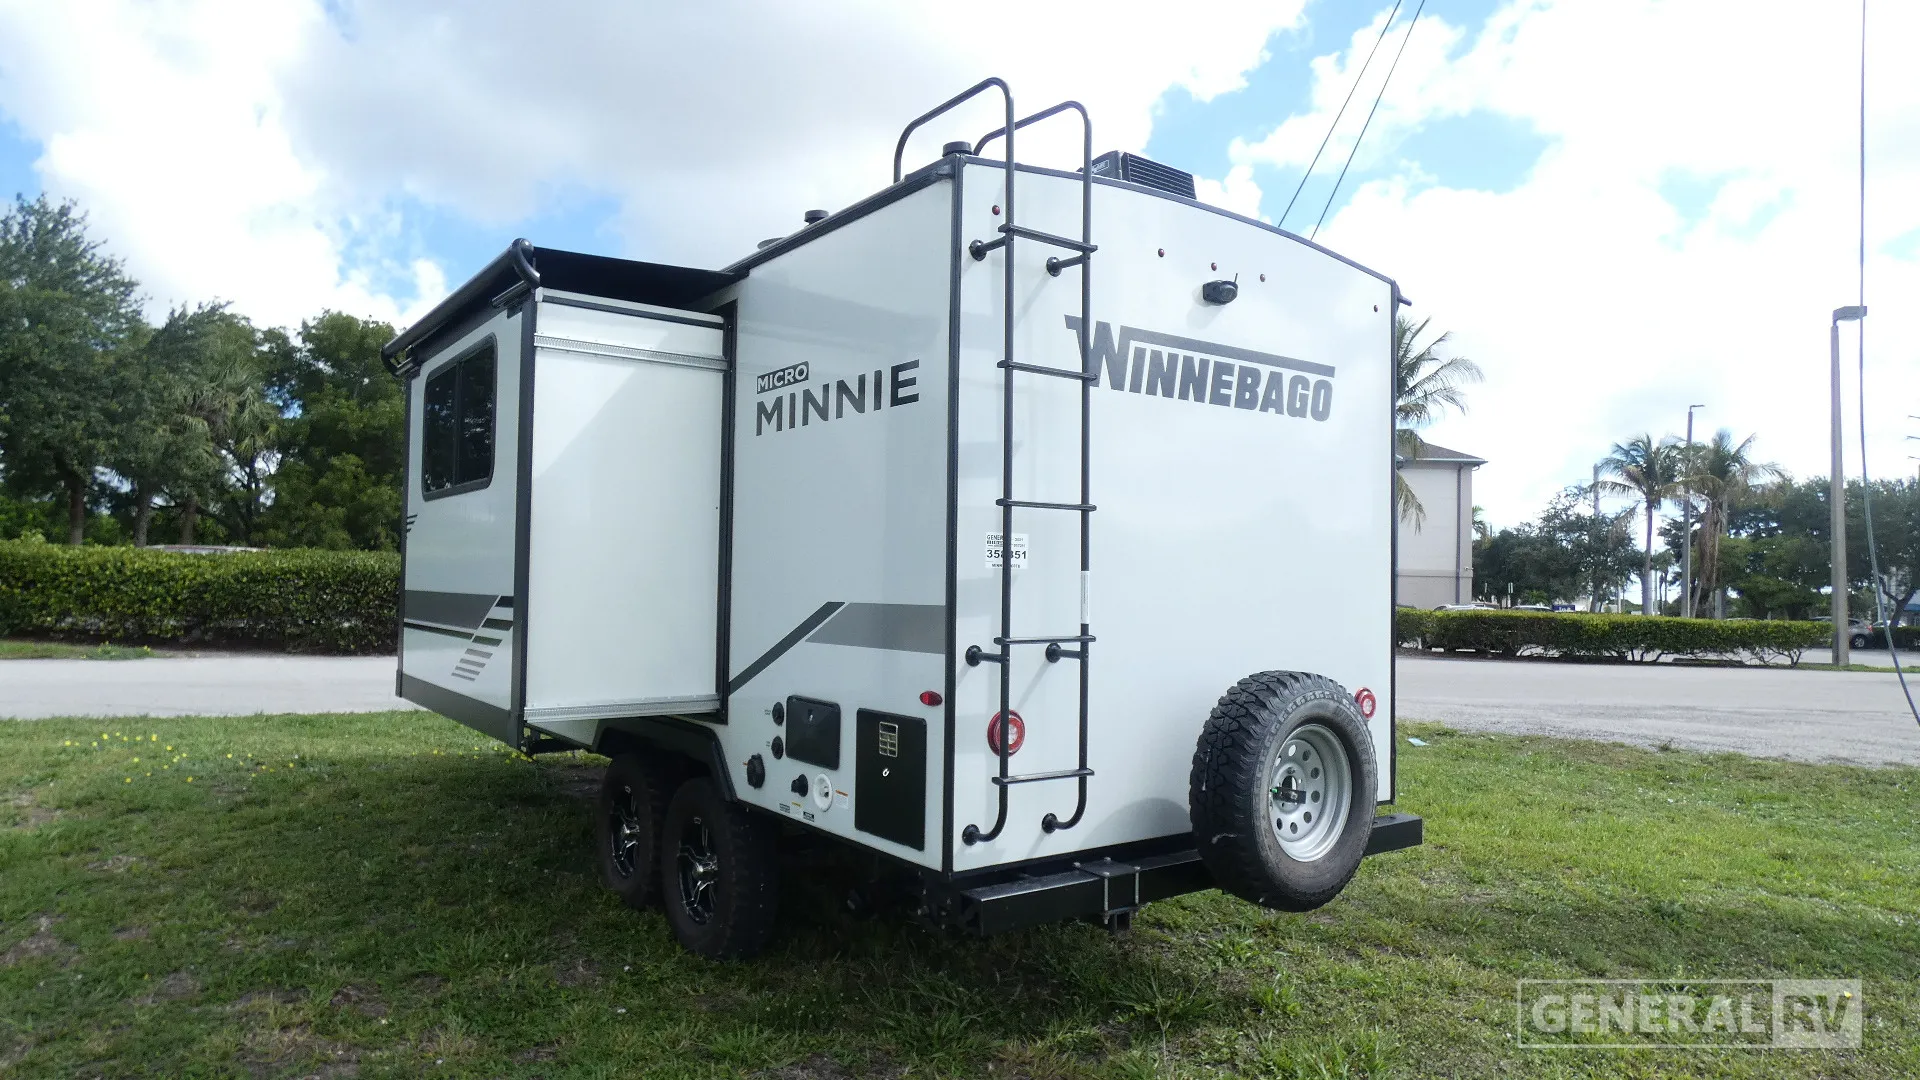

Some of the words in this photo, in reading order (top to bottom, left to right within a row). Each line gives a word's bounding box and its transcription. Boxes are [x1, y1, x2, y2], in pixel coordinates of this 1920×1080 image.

[756, 359, 919, 436] MINNIE
[757, 364, 808, 392] MICRO
[1064, 314, 1335, 422] WINNEBAGO
